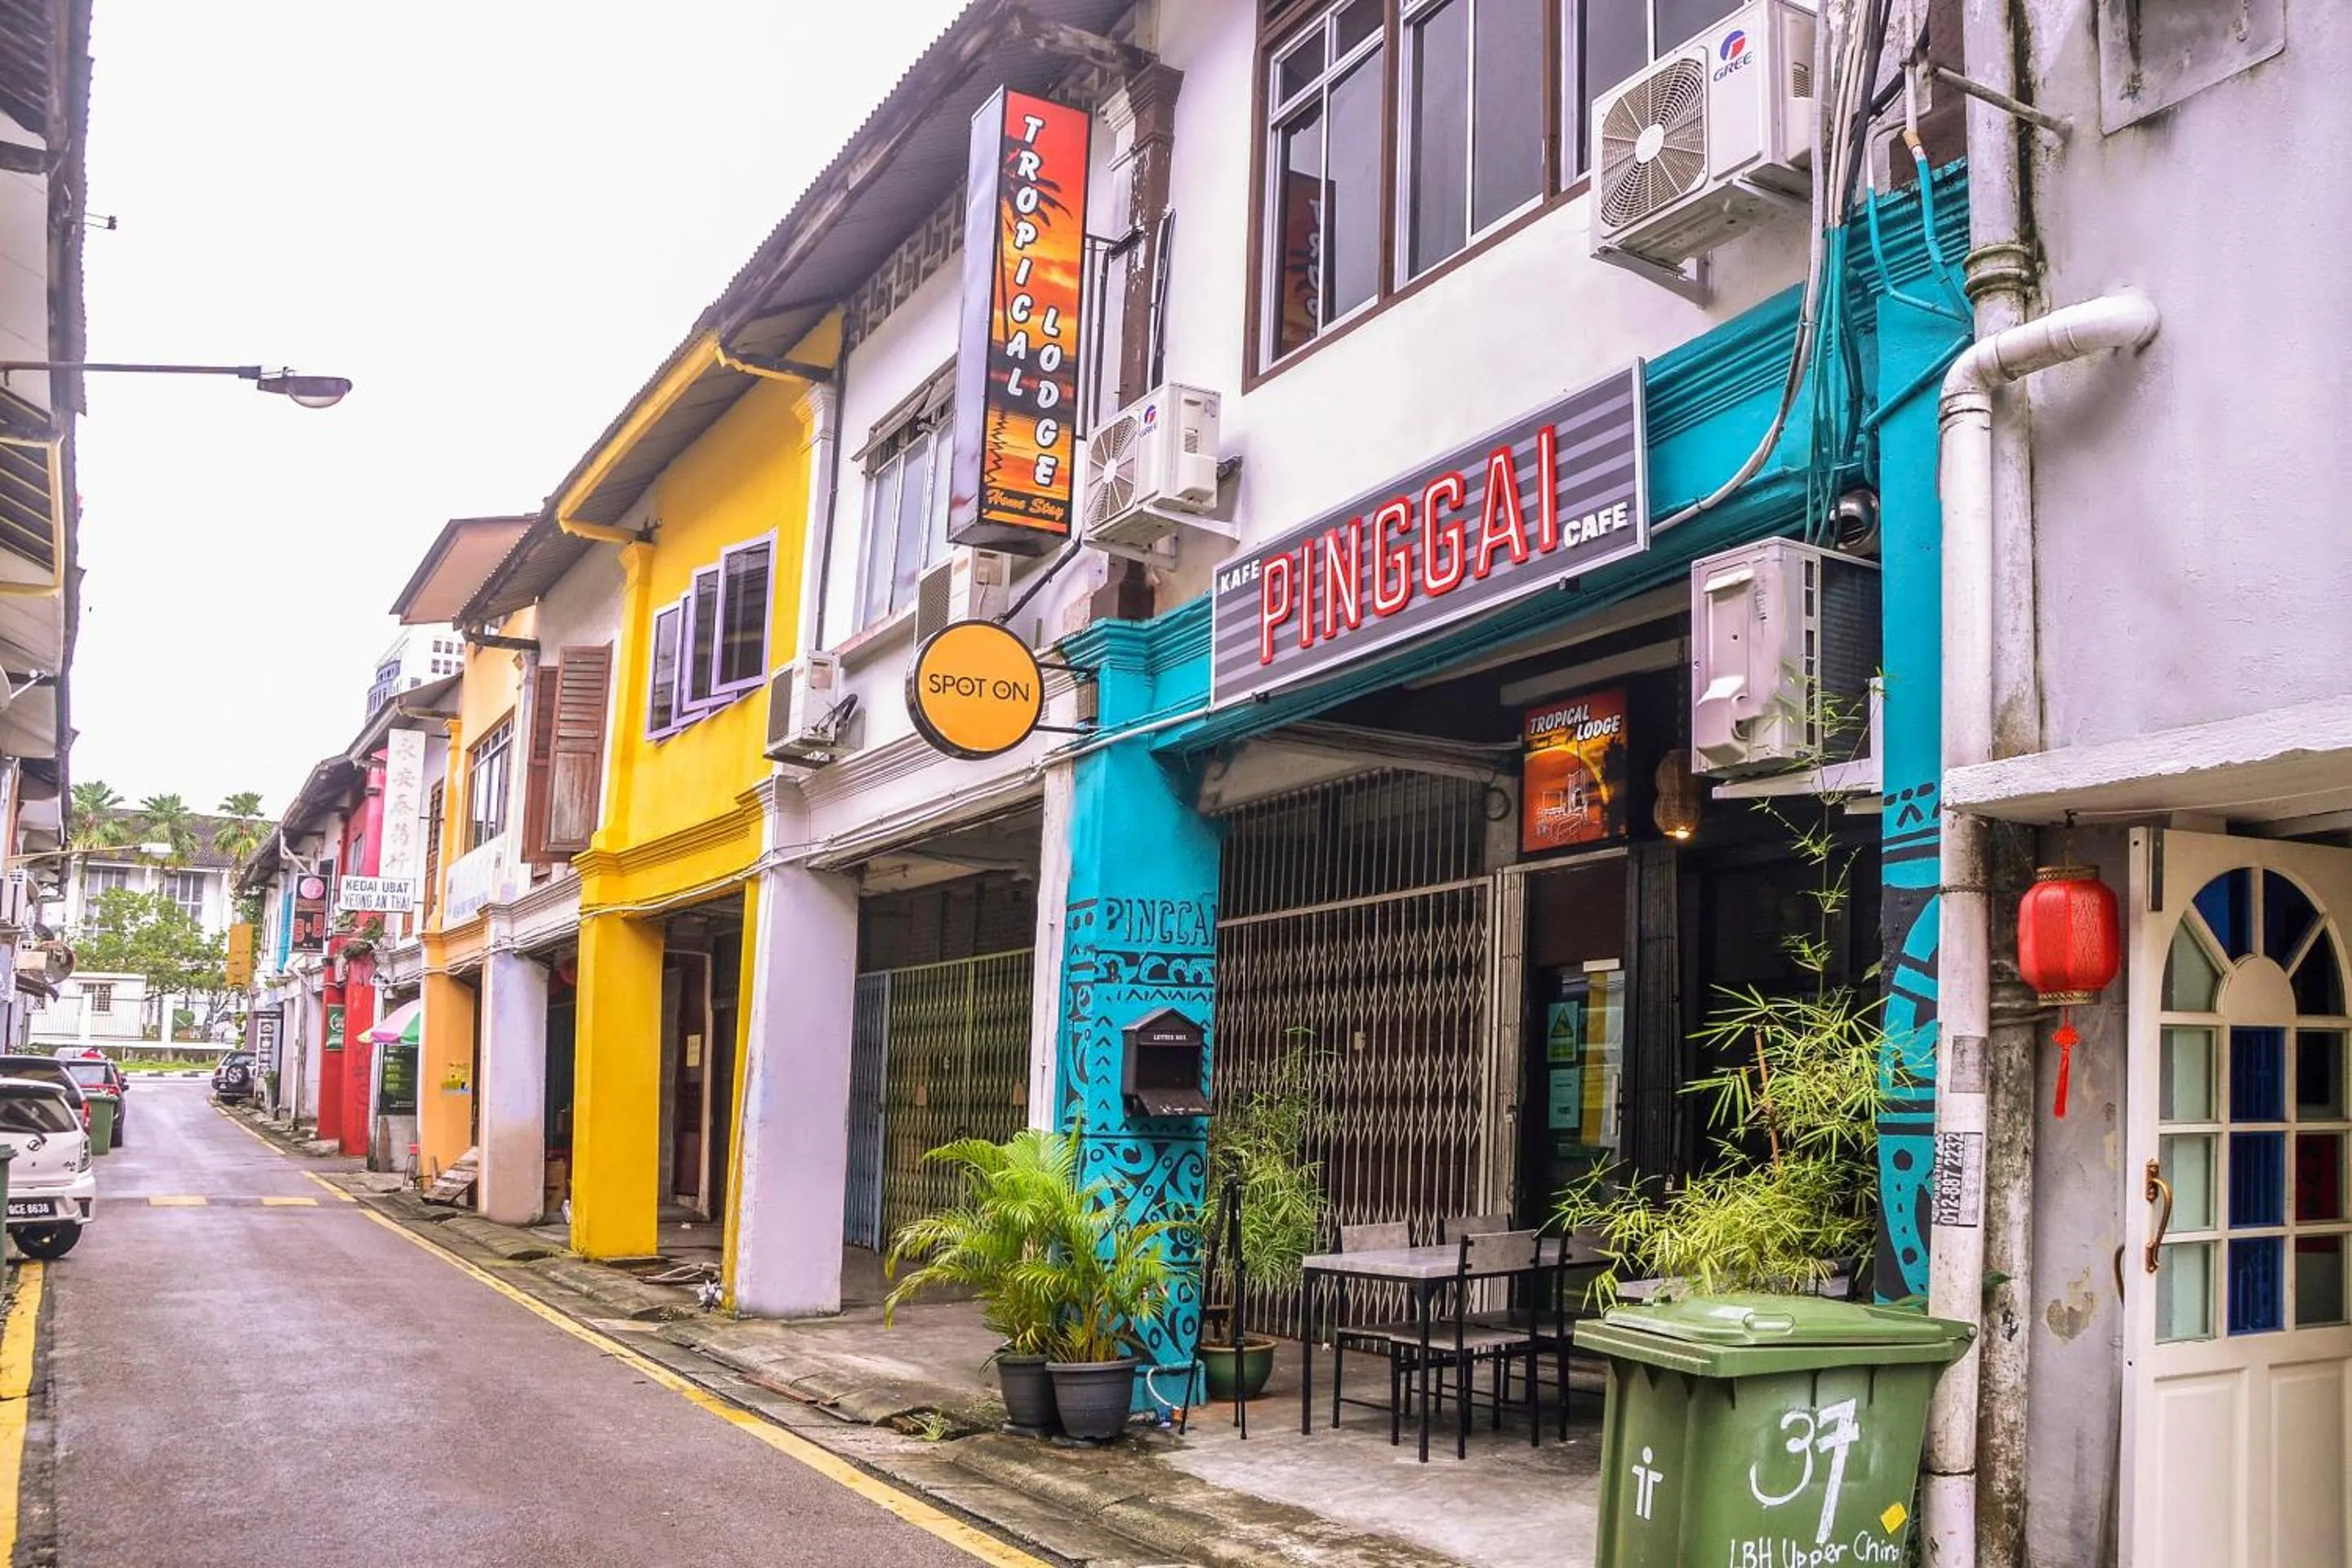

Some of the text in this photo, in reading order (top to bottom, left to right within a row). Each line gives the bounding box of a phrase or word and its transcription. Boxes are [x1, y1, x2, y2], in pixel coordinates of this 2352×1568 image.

[1713, 51, 1753, 82] GREE
[1005, 114, 1045, 398] TROPICAL
[1033, 305, 1062, 488] LODGE
[1220, 423, 1630, 666] KAFE PINGGAI CAFE
[929, 673, 1030, 702] SPOT ON
[1530, 703, 1590, 735] TROPICAL
[1576, 714, 1621, 742] LODGE
[345, 879, 410, 893] KEDAI UBAT
[1748, 1397, 1860, 1544] 37
[1782, 1539, 1848, 1568] Upper
